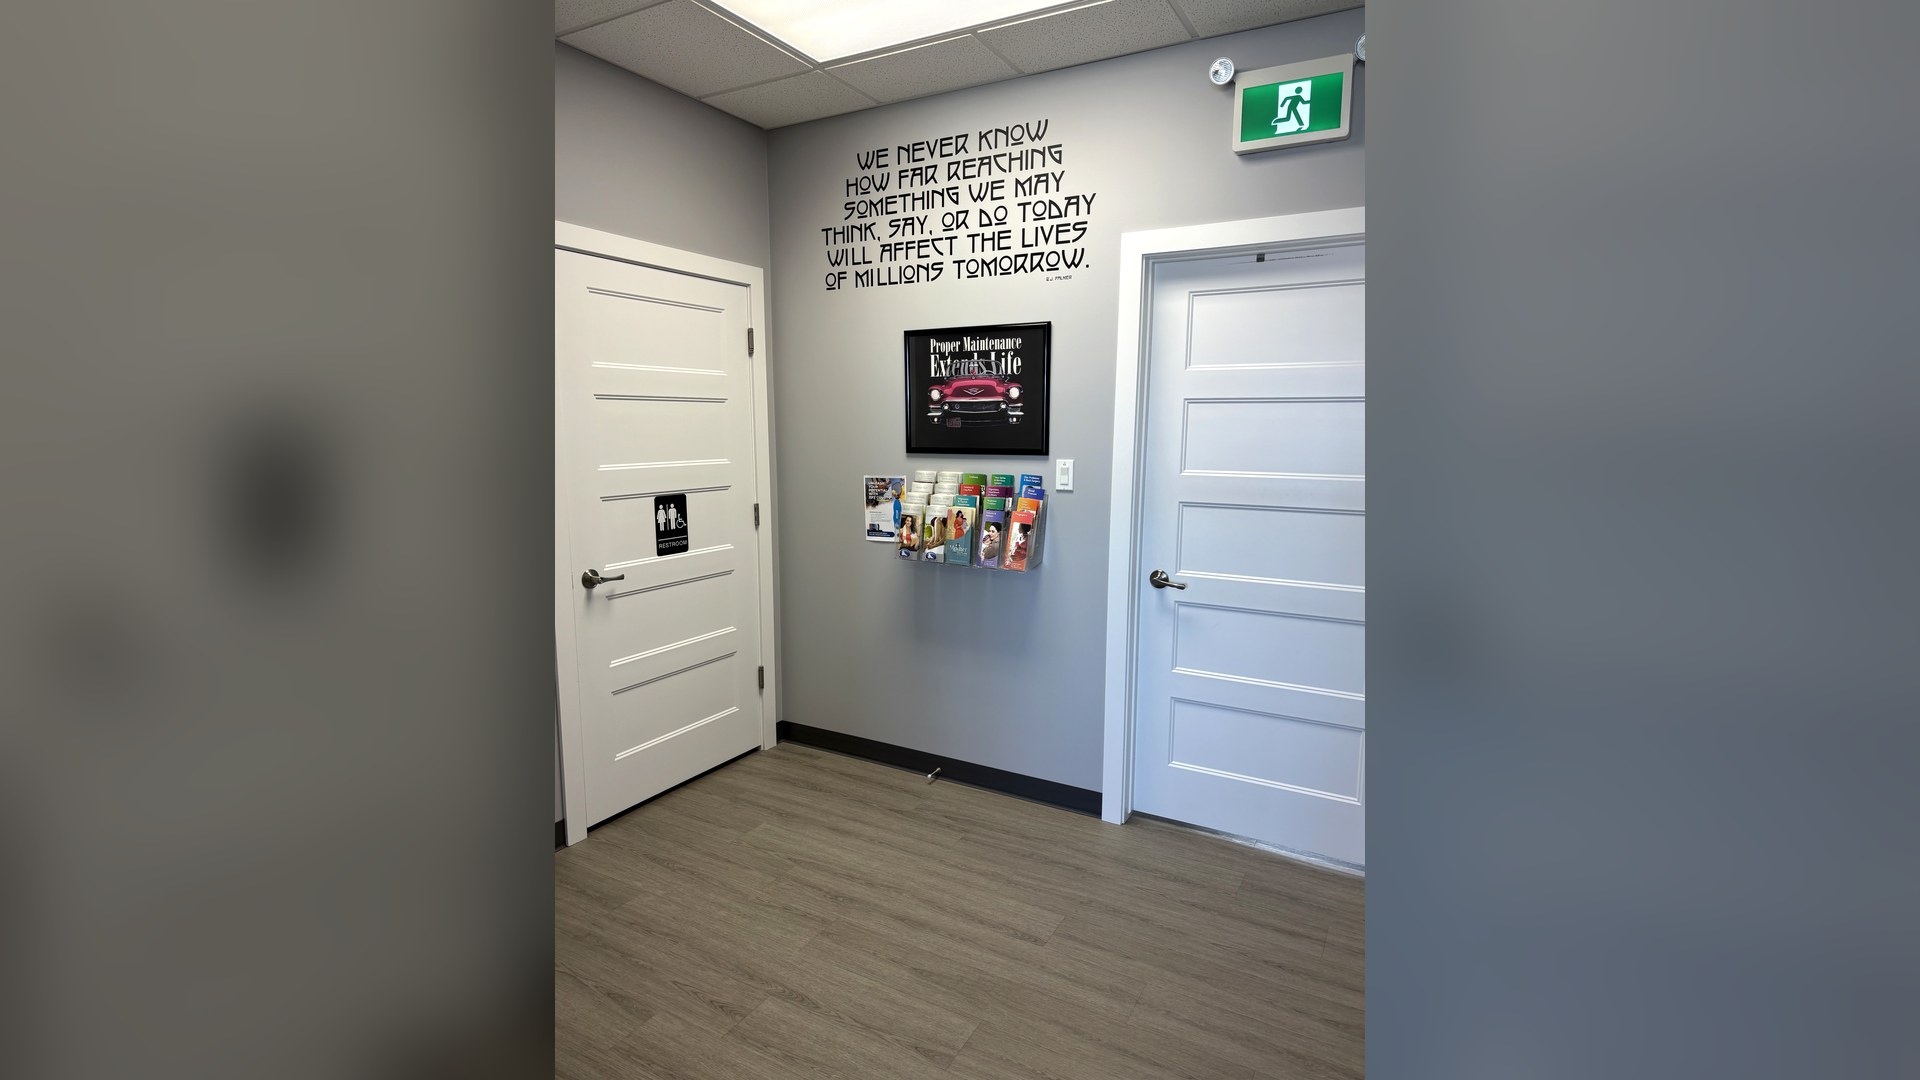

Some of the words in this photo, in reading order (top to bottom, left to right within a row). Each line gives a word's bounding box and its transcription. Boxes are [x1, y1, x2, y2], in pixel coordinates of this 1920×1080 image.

[857, 148, 888, 171] WE
[898, 134, 968, 165] NEVER
[979, 119, 1048, 151] KNOW
[846, 172, 890, 197] HOW
[899, 165, 937, 189] FAR
[948, 144, 1062, 181] REACHING
[844, 186, 958, 220] SOMETHING
[969, 180, 1004, 202] WE
[1015, 171, 1064, 197] MAY
[821, 222, 880, 246] THINK,
[889, 215, 932, 238] SAY,
[942, 210, 969, 231] OR
[980, 206, 1007, 227] DO
[1018, 193, 1096, 222] TODAY
[827, 247, 872, 267] WILL
[880, 236, 957, 262] AFFECT
[967, 230, 1011, 253] THE
[1022, 221, 1087, 248] LIVES
[826, 271, 847, 290] OF
[855, 262, 943, 288] MILLIONS
[953, 248, 1089, 279] TOMORROW.
[930, 338, 960, 356] Proper
[963, 336, 1022, 352] Maintenance
[989, 350, 1022, 376] Life
[659, 540, 687, 549] RESTROOM
